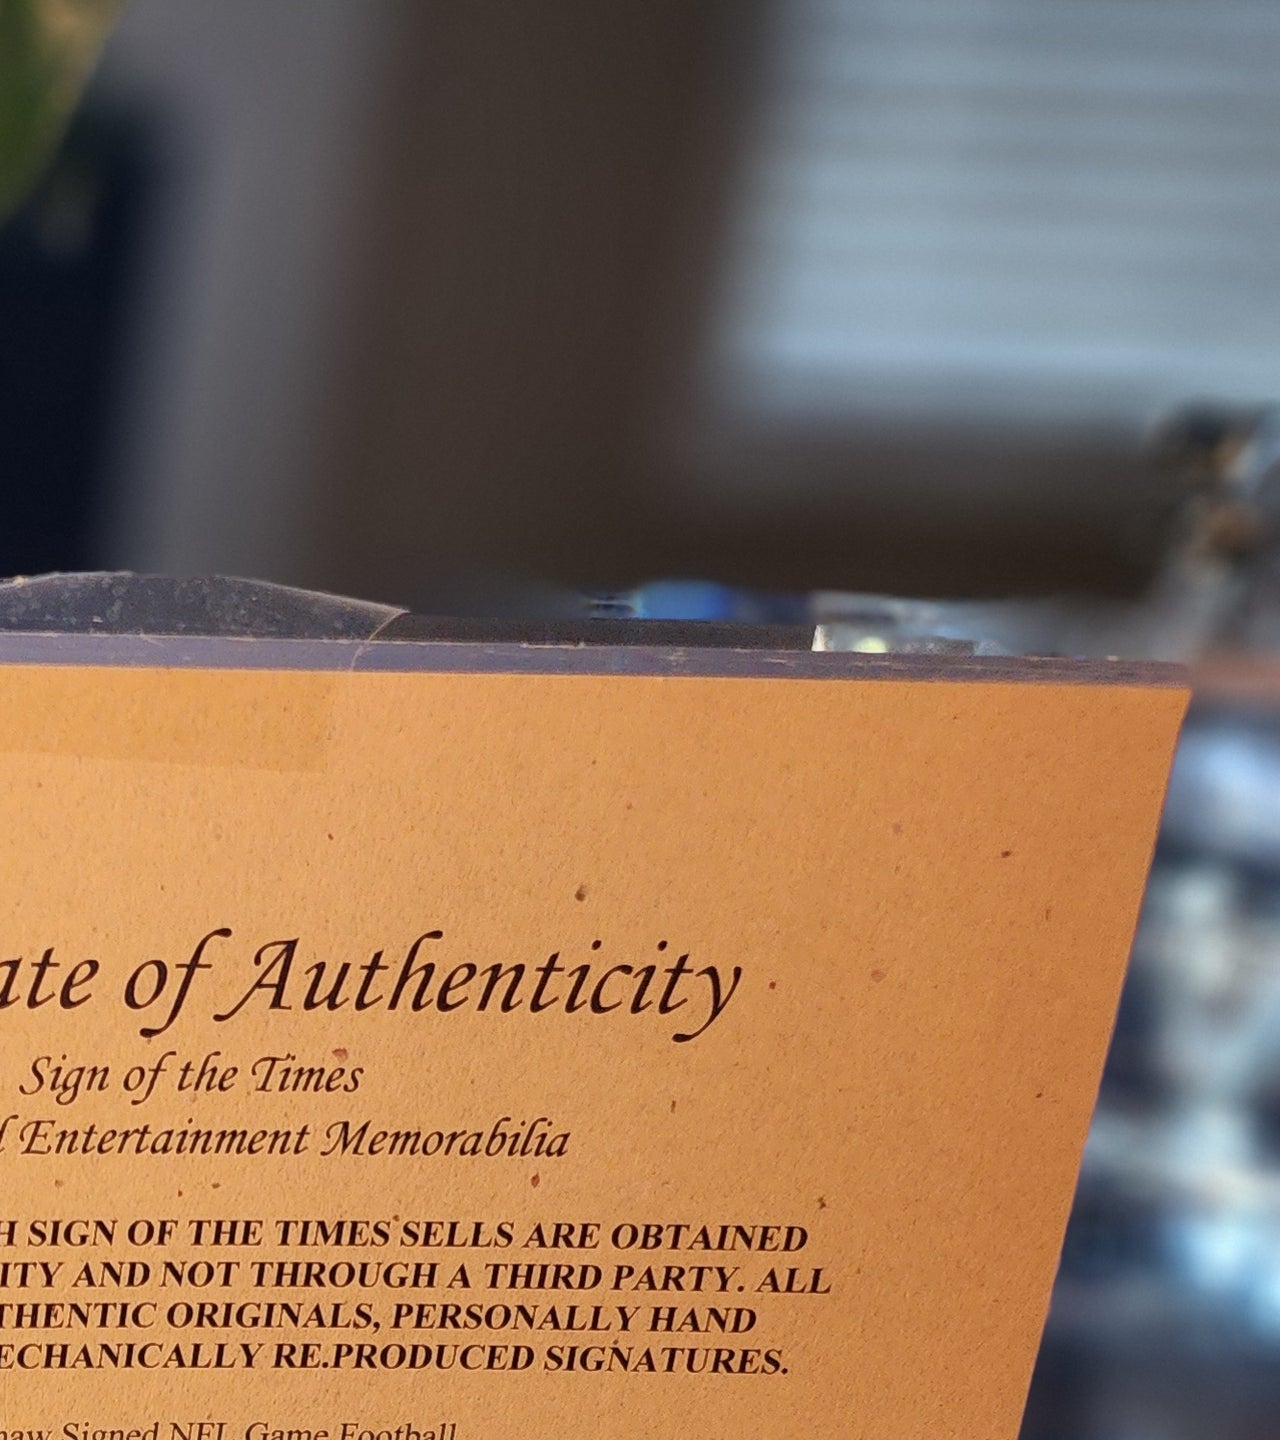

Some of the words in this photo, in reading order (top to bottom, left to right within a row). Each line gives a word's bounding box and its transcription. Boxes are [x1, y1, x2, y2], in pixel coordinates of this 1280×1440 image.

[123, 927, 233, 1041] of
[214, 929, 744, 1044] Authenticity
[18, 1054, 111, 1104] Sign
[122, 1050, 178, 1106] of
[176, 1052, 239, 1095] the
[250, 1050, 365, 1094] Times
[18, 1116, 311, 1156] Entertainment
[319, 1116, 572, 1158] Memorabilia
[26, 1217, 120, 1248] SIGN
[127, 1218, 176, 1247] OF
[188, 1218, 264, 1247] THE
[275, 1219, 392, 1248] TIMES
[399, 1218, 516, 1249] SELLS
[521, 1221, 601, 1250] ARE
[610, 1222, 809, 1253] OBTAINED
[70, 1259, 152, 1291] AND
[158, 1259, 241, 1288] NOT
[250, 1259, 441, 1289] THROUGH
[445, 1261, 472, 1291] A
[484, 1261, 603, 1291] THIRD
[610, 1263, 746, 1294] PARTY.
[753, 1266, 833, 1295] ALL
[166, 1300, 381, 1336] ORIGINALS,
[390, 1301, 641, 1334] PERSONALLY
[645, 1305, 758, 1335] HAND
[542, 1344, 789, 1376] SIGNATURES.
